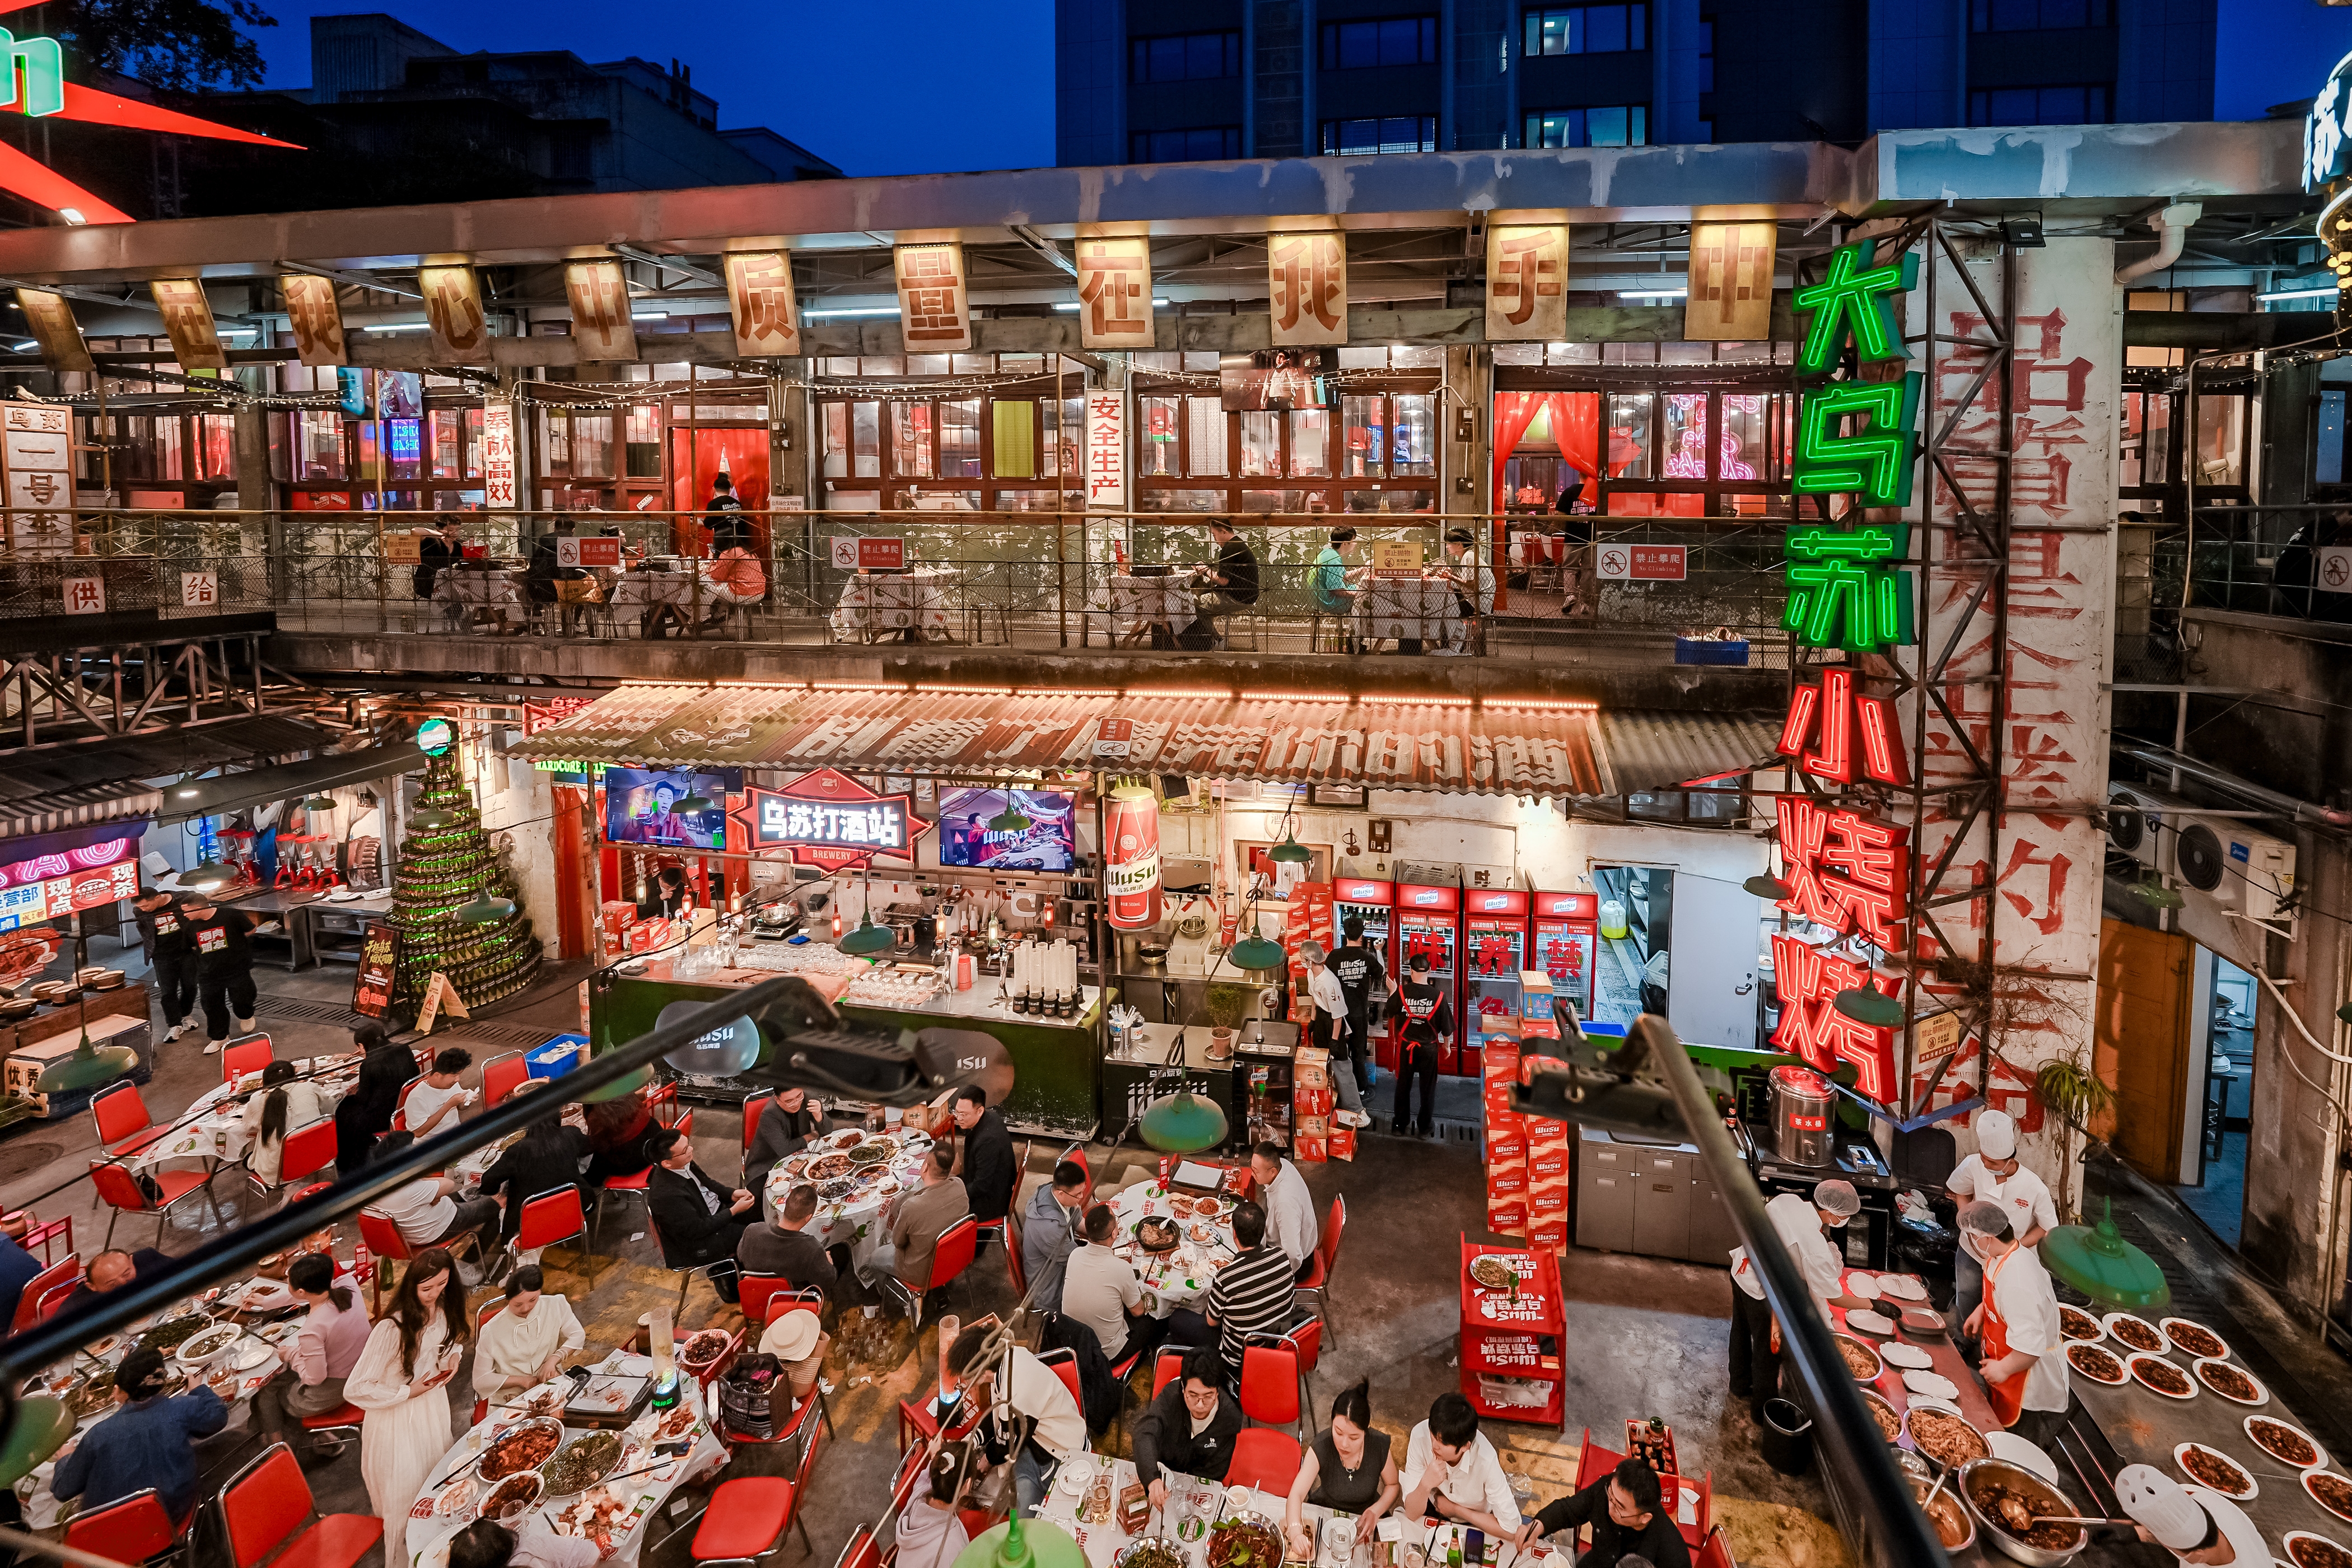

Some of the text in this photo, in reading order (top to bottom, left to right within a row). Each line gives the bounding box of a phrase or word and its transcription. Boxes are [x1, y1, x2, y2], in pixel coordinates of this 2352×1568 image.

[732, 255, 795, 341] 质
[900, 251, 964, 340] 量
[1080, 245, 1146, 335] 在
[1273, 239, 1342, 331] 我
[1493, 230, 1561, 325] 手
[1695, 227, 1768, 323] 中
[284, 278, 340, 356] 我
[430, 273, 482, 349] 心
[572, 267, 629, 346] 中
[10, 409, 63, 430] 乌苏
[487, 411, 512, 502] 奉献高效
[1090, 396, 1121, 500] 安全生产
[583, 542, 619, 554] 禁止攀爬
[862, 543, 899, 556] 禁止攀爬
[1635, 552, 1680, 564] 禁止攀爬
[68, 582, 99, 610] 供
[187, 577, 214, 601] 给
[1770, 241, 1911, 1105] 大乌苏 小烧烤
[535, 760, 581, 773] HARDCORE
[762, 800, 899, 847] 乌苏打酒站
[813, 850, 851, 860] BREWERY
[46, 878, 73, 915] 现点
[111, 862, 136, 898] 现杀
[1547, 939, 1581, 978] 禁
[1795, 1118, 1822, 1127] 茶水桶
